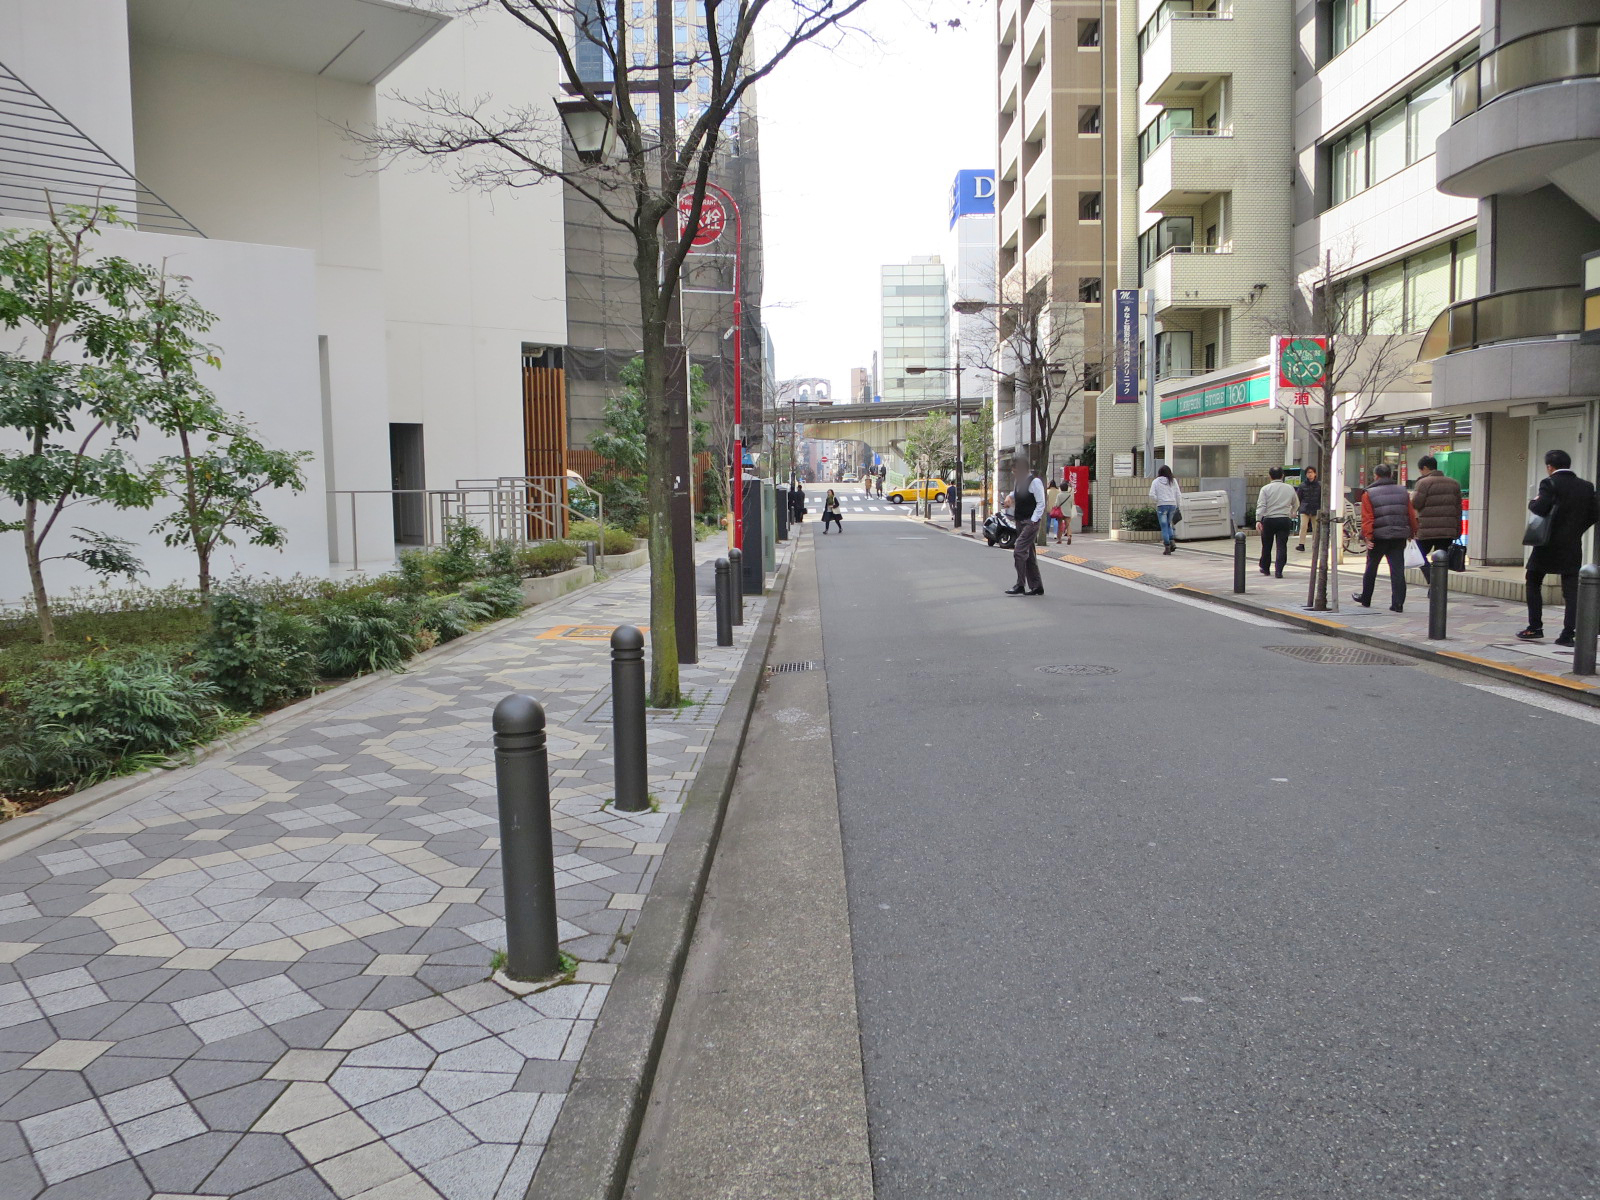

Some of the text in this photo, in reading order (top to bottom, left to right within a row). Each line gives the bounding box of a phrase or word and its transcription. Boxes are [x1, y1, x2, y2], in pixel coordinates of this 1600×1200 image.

[1205, 391, 1225, 407] STORE
[1228, 383, 1246, 405] 100
[1294, 391, 1309, 405] 酒
